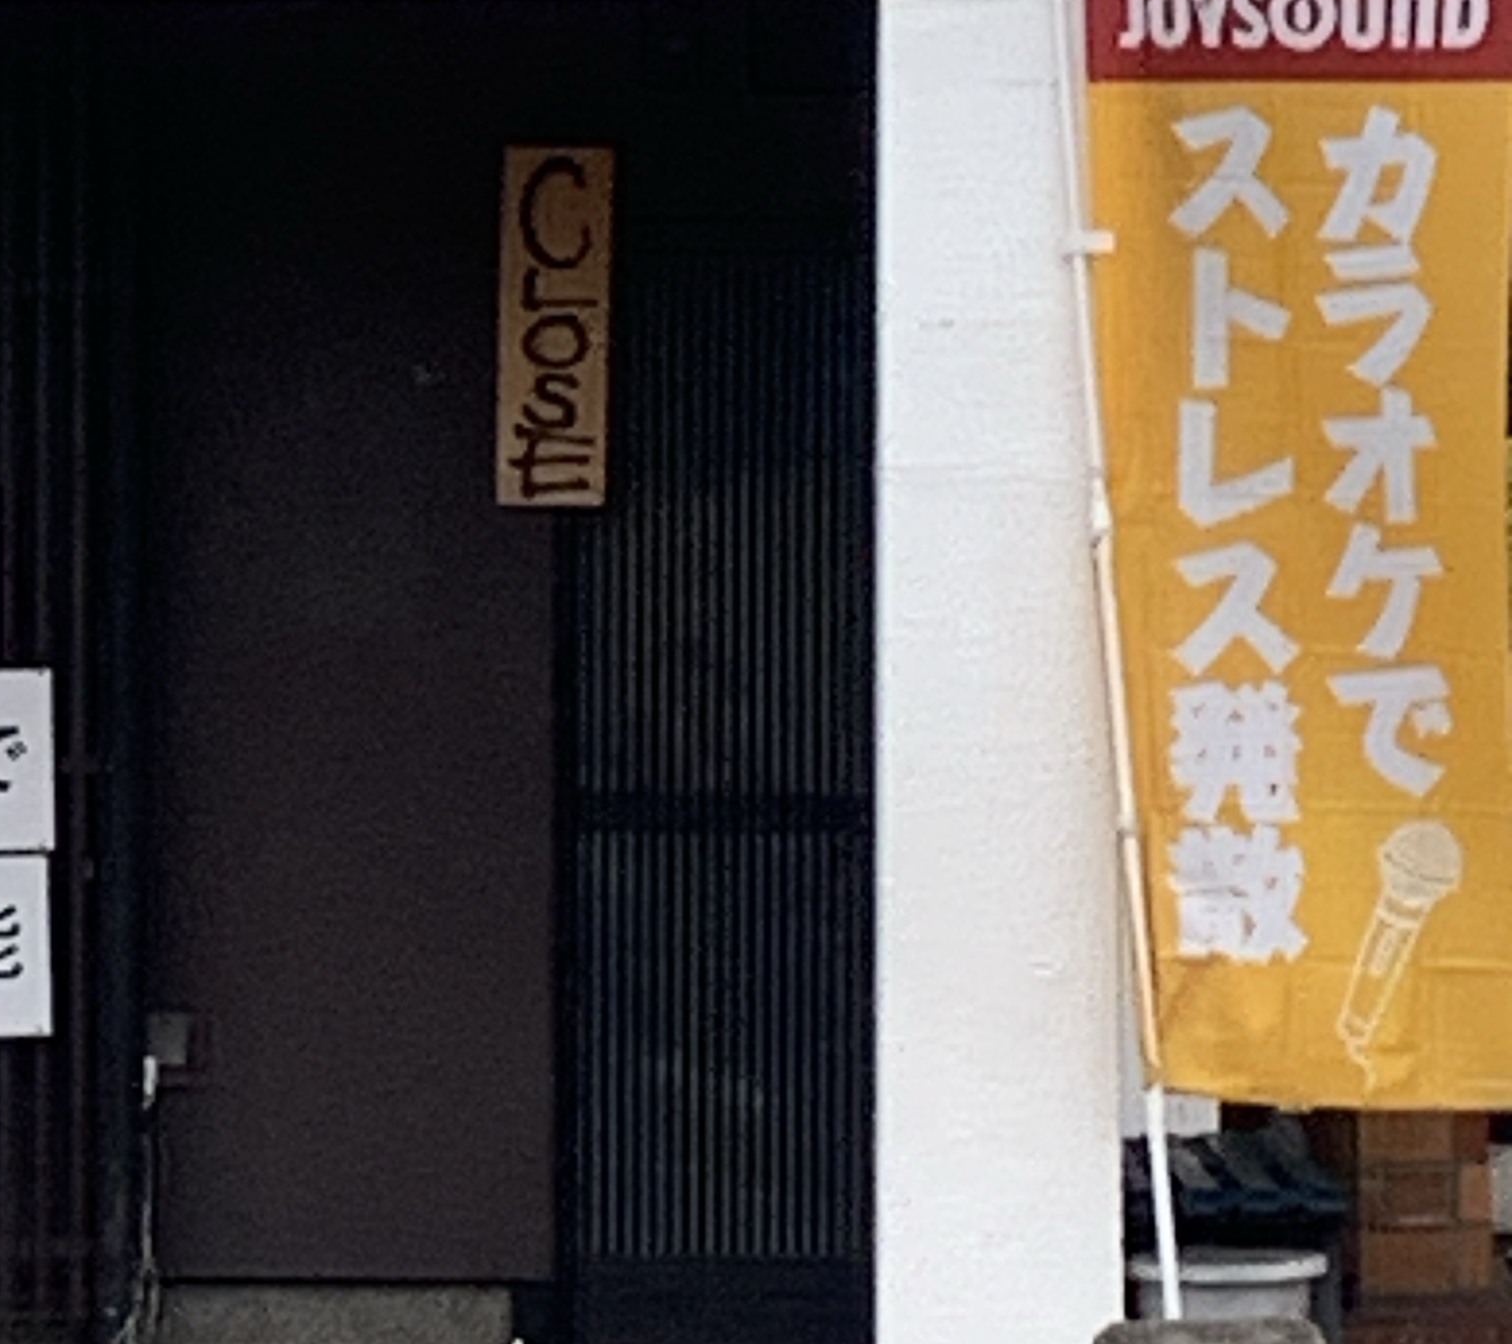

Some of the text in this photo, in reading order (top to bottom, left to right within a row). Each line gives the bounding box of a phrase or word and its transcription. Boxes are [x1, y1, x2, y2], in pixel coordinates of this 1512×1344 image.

[1165, 105, 1310, 965] ストレス発散
[1315, 105, 1454, 798] カラオケで
